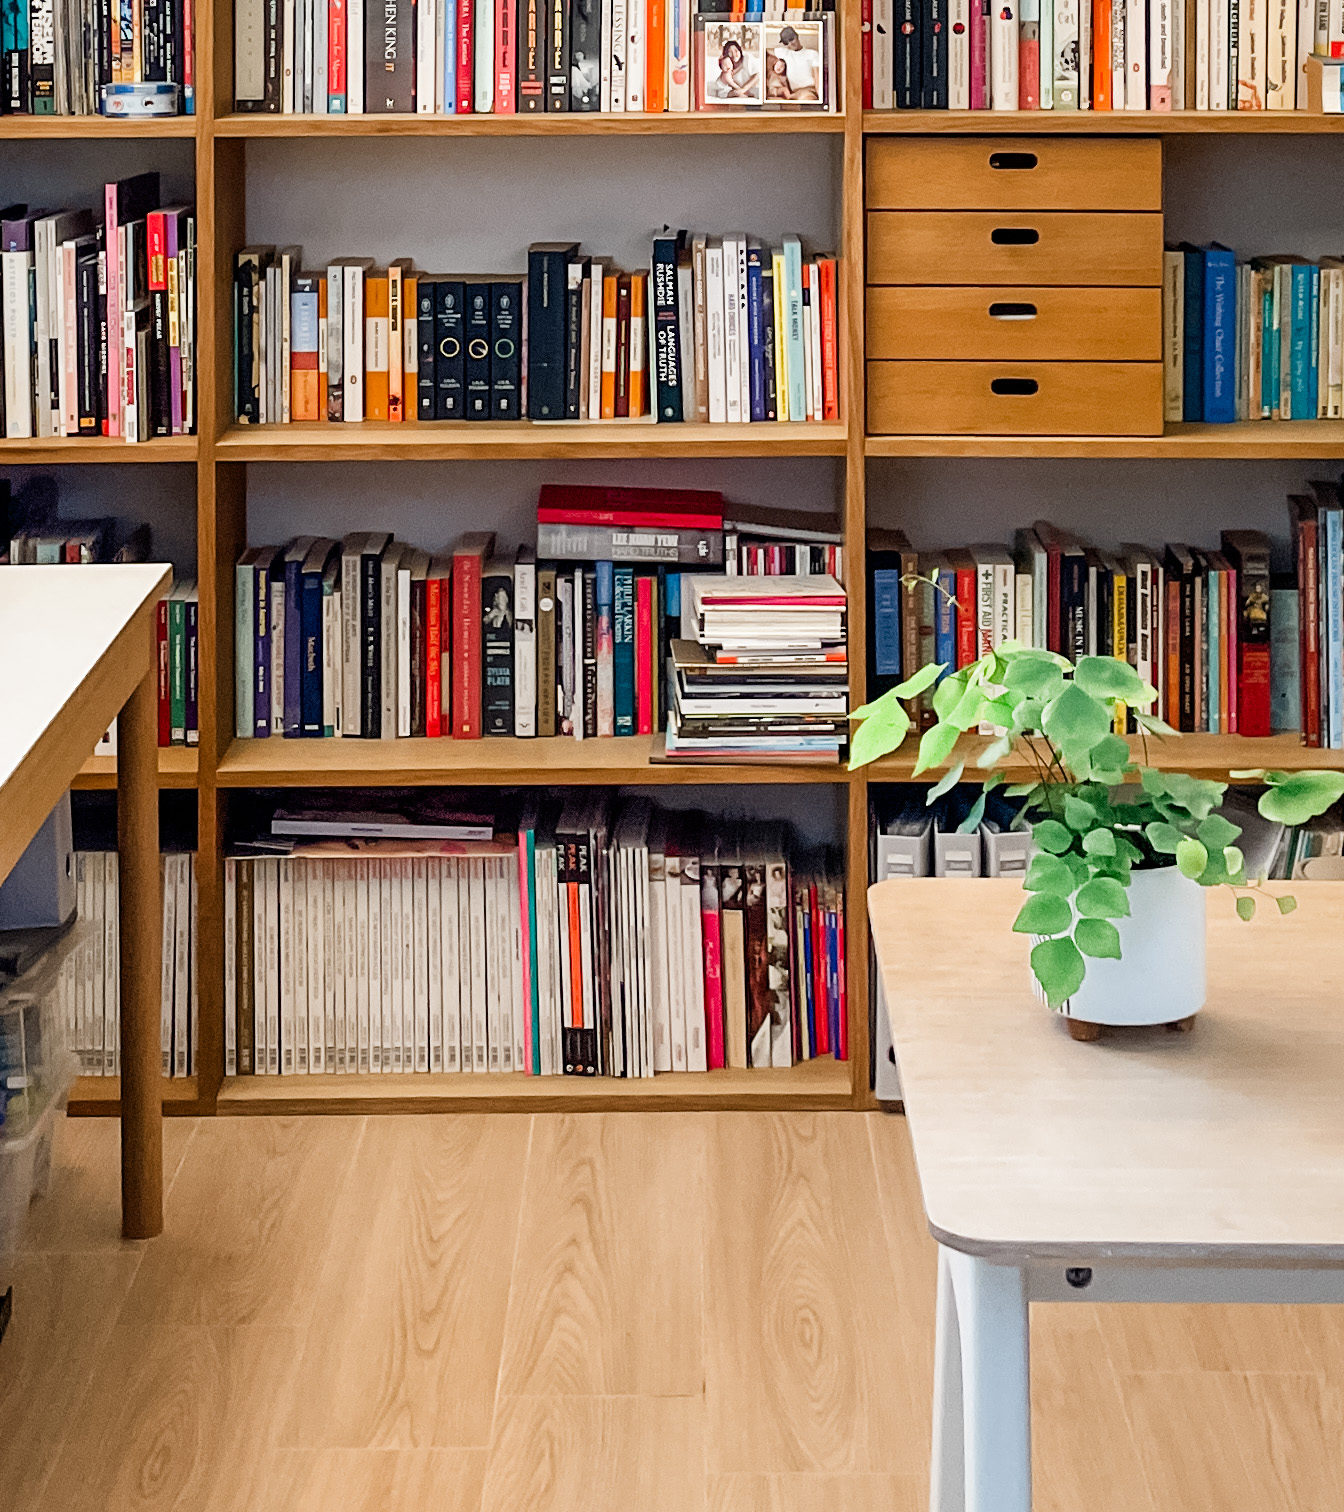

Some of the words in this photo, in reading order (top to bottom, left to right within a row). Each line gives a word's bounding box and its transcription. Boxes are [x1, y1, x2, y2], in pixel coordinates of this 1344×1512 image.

[31, 12, 42, 65] TERROR
[614, 5, 624, 52] LESSING
[385, 28, 396, 59] KING
[385, 63, 394, 72] IT
[656, 263, 665, 306] RUSHDIE
[664, 264, 673, 305] SALMAN
[658, 330, 666, 344] OF
[1215, 329, 1225, 352] Chair
[659, 347, 667, 381] TRUTH
[667, 325, 676, 386] LANGUAGES
[430, 584, 438, 605] More
[982, 582, 992, 608] FIRST
[430, 607, 438, 625] than
[624, 607, 633, 643] LARKIN
[982, 611, 992, 627] AID
[1075, 606, 1084, 633] MUSIC
[1117, 585, 1125, 656] DHAMMAPADA
[307, 637, 316, 671] Macbeth
[1076, 636, 1084, 646] IN
[557, 845, 566, 871] PEAK
[567, 844, 576, 870] PEAK
[579, 845, 588, 872] PEAK
